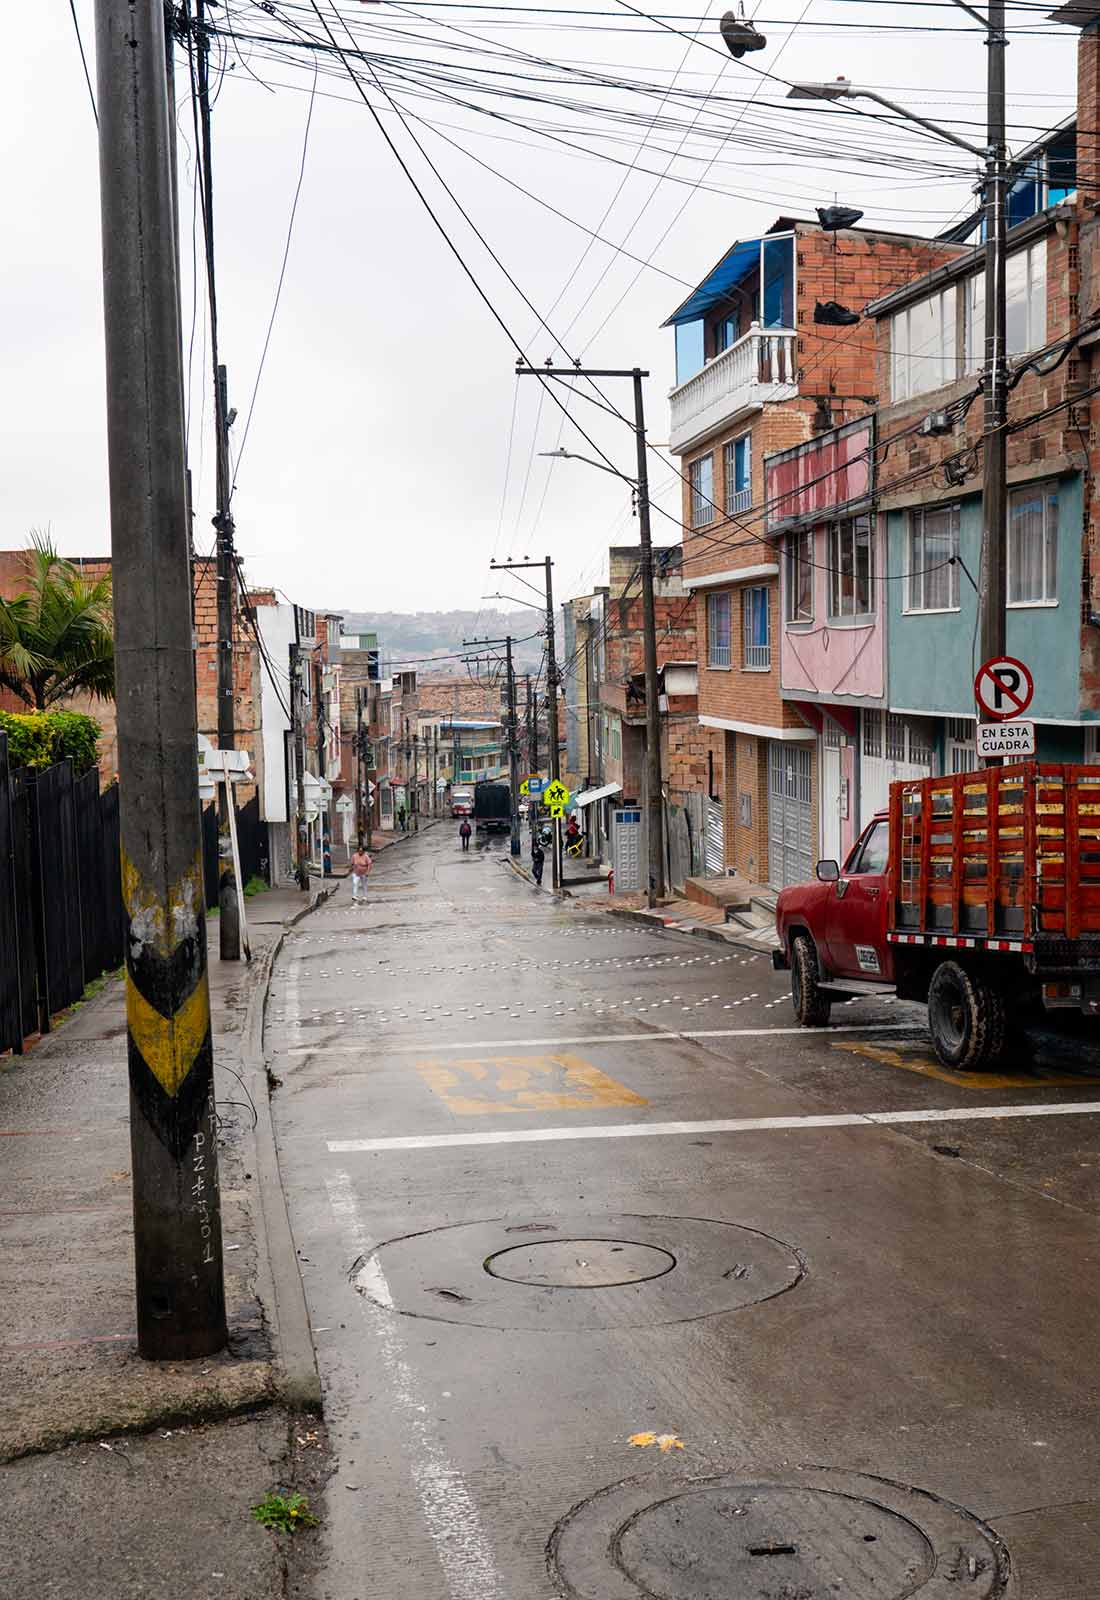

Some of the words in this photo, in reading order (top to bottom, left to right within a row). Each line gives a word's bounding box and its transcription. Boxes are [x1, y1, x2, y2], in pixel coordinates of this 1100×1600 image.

[994, 669, 1019, 708] P
[982, 729, 995, 738] EN
[1001, 728, 1029, 737] ESTA
[982, 740, 1030, 751] CUADRA
